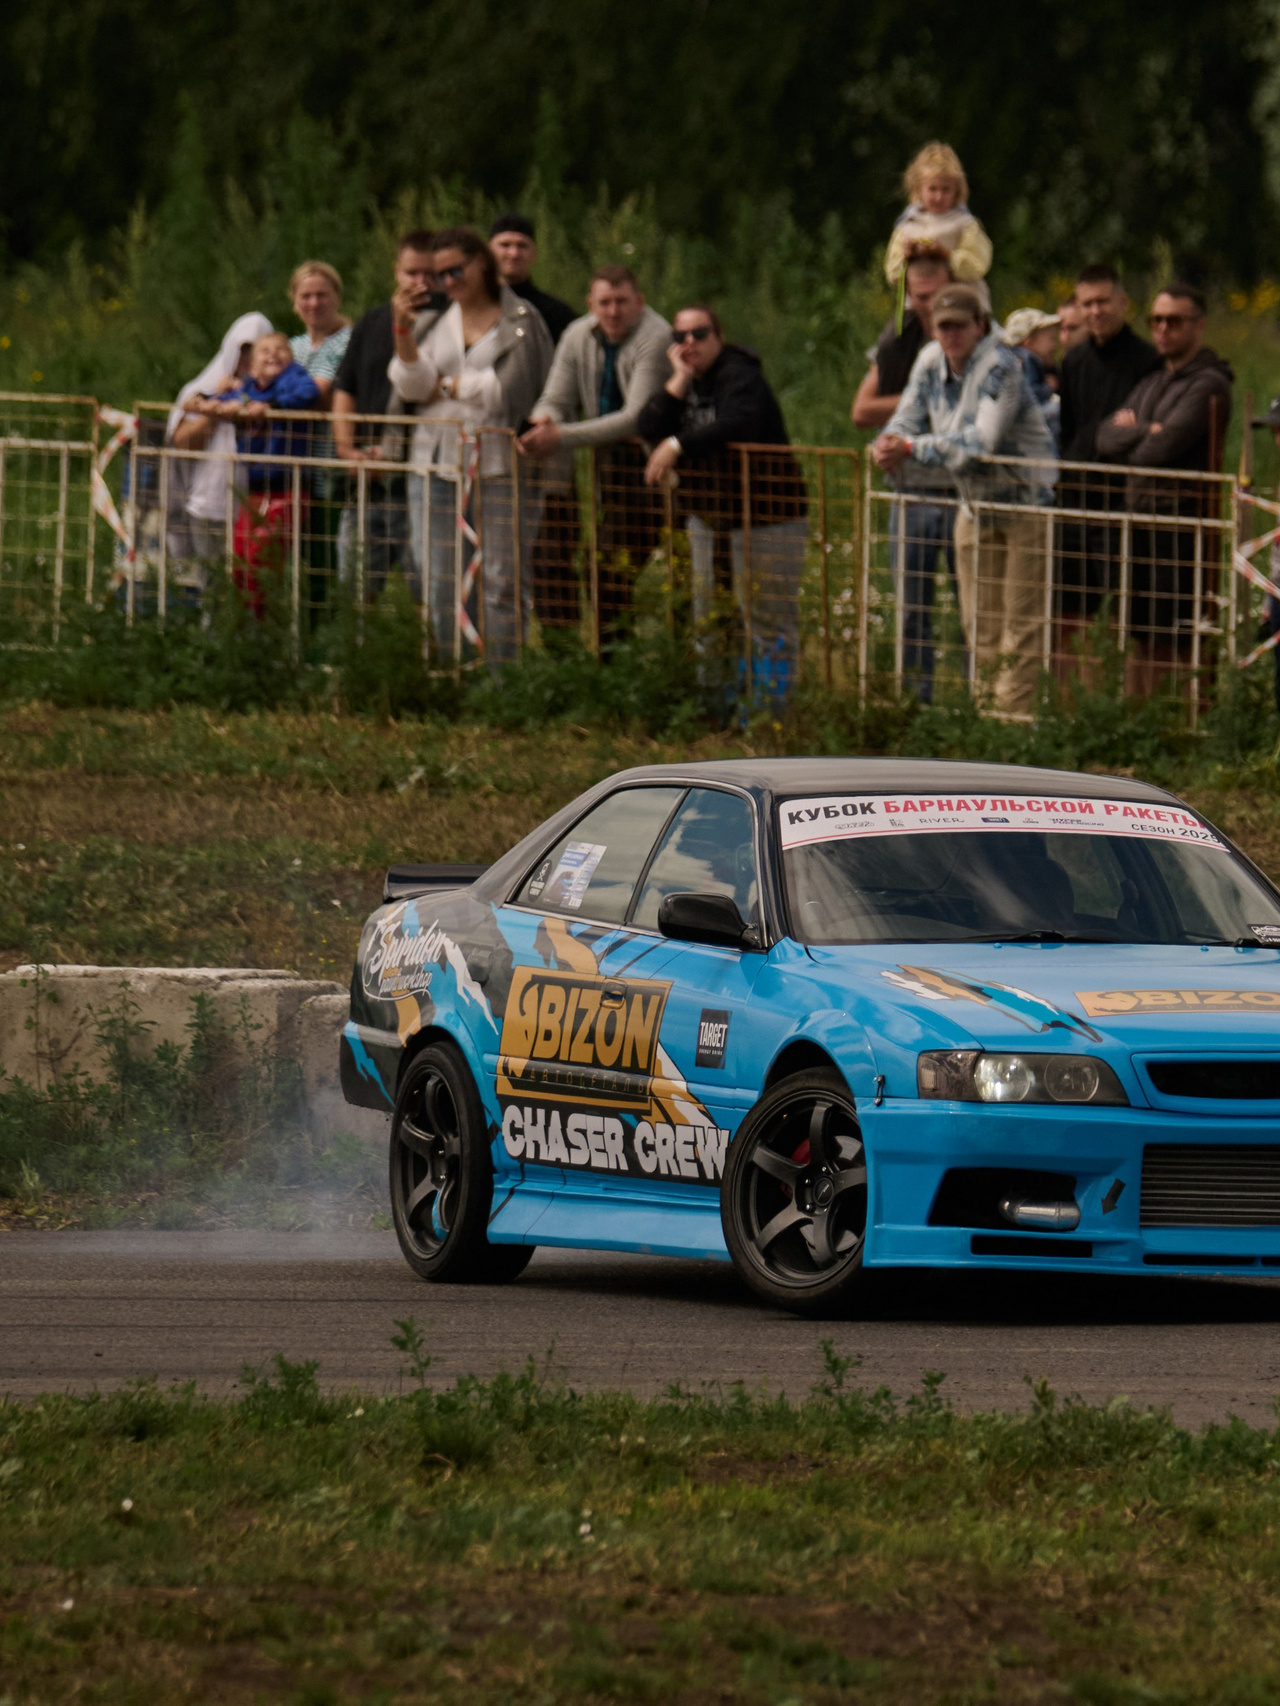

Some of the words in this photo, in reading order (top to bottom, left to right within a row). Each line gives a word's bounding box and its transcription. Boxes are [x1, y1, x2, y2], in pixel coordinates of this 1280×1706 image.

[787, 802, 877, 825] КУБОК
[883, 799, 1095, 815] БАРНАУЛЬСКОЙ
[1131, 823, 1175, 835] СЕЗОН
[532, 984, 661, 1069] BIZON
[699, 1021, 728, 1048] TARGET
[502, 1104, 629, 1171] CHASER
[633, 1120, 731, 1180] CREW
